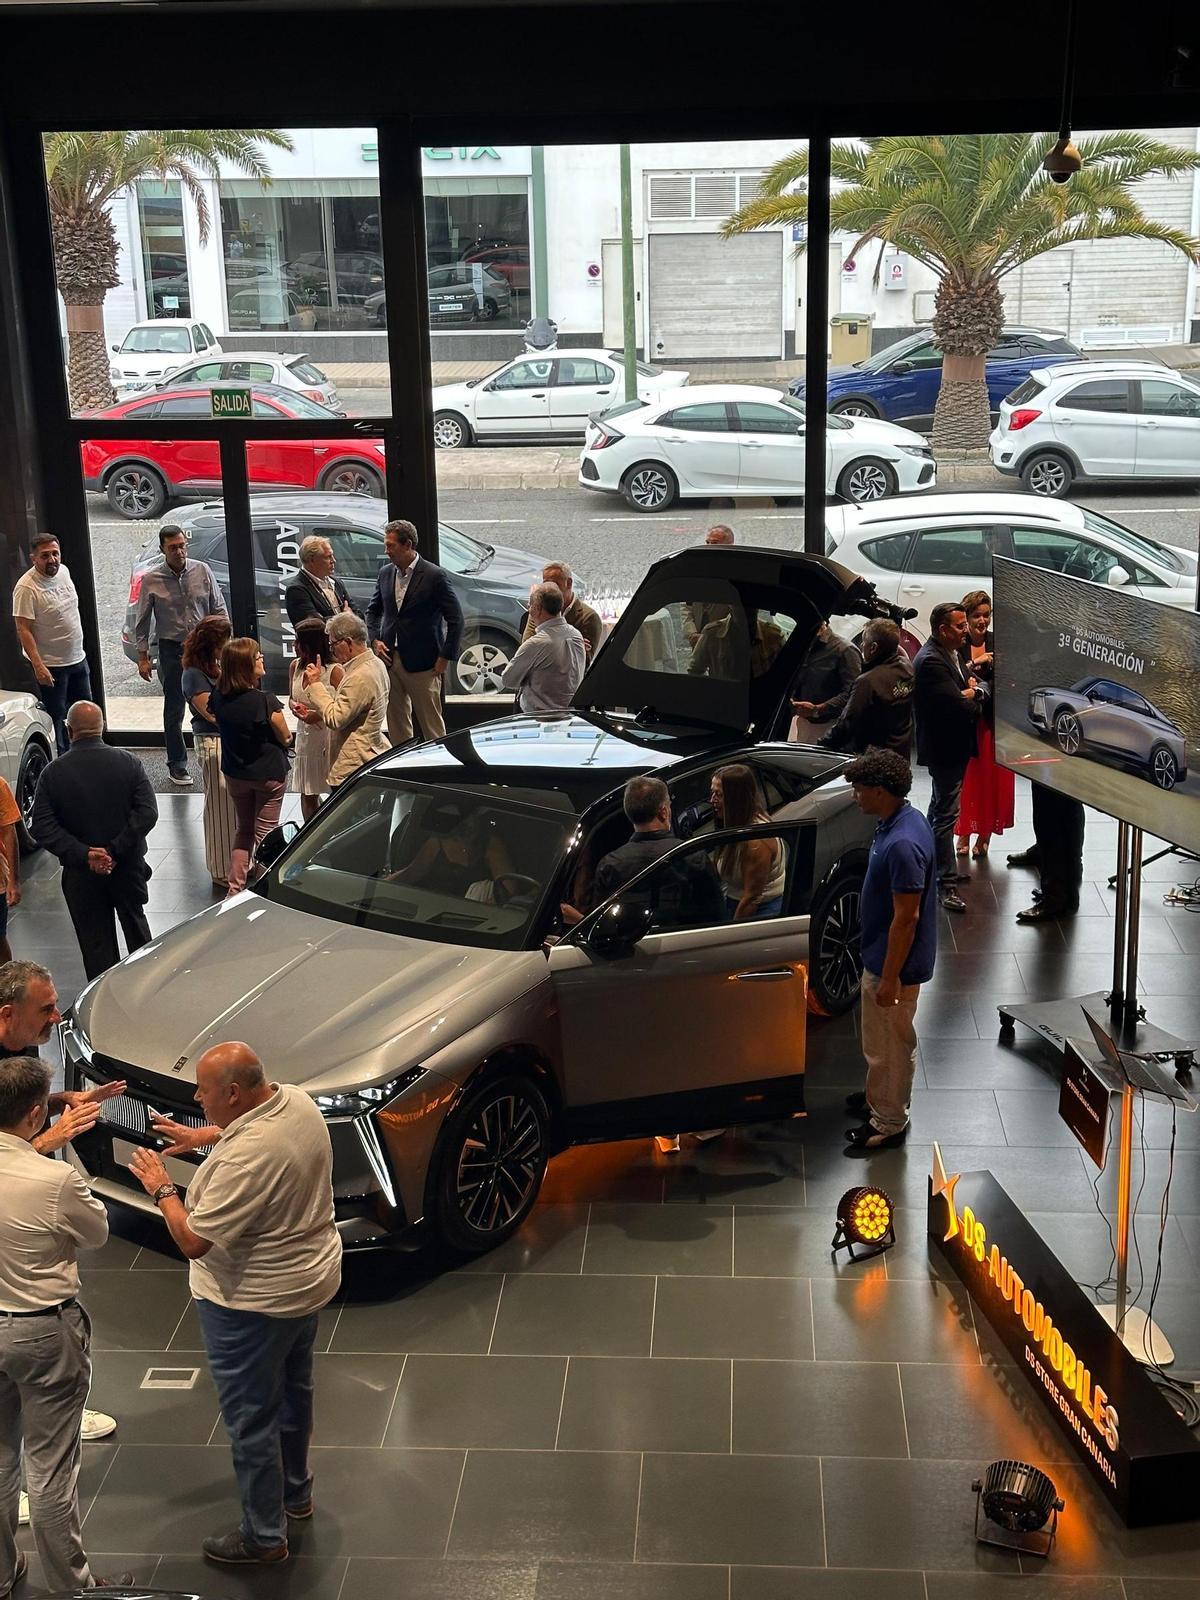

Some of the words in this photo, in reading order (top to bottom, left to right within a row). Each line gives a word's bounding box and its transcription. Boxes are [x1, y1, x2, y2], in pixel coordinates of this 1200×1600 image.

[213, 394, 250, 411] SALIDA
[275, 519, 301, 658] ENADA
[1072, 637, 1144, 675] GENERACIÓN
[1083, 629, 1125, 650] AUTOMOBILES
[963, 1205, 986, 1263] DS
[989, 1244, 1120, 1451] AUTOMOBILES
[1025, 1344, 1035, 1369] DS
[1035, 1367, 1059, 1404] STORE
[1059, 1397, 1081, 1435] GRAN
[1081, 1427, 1118, 1489] CANARIA
